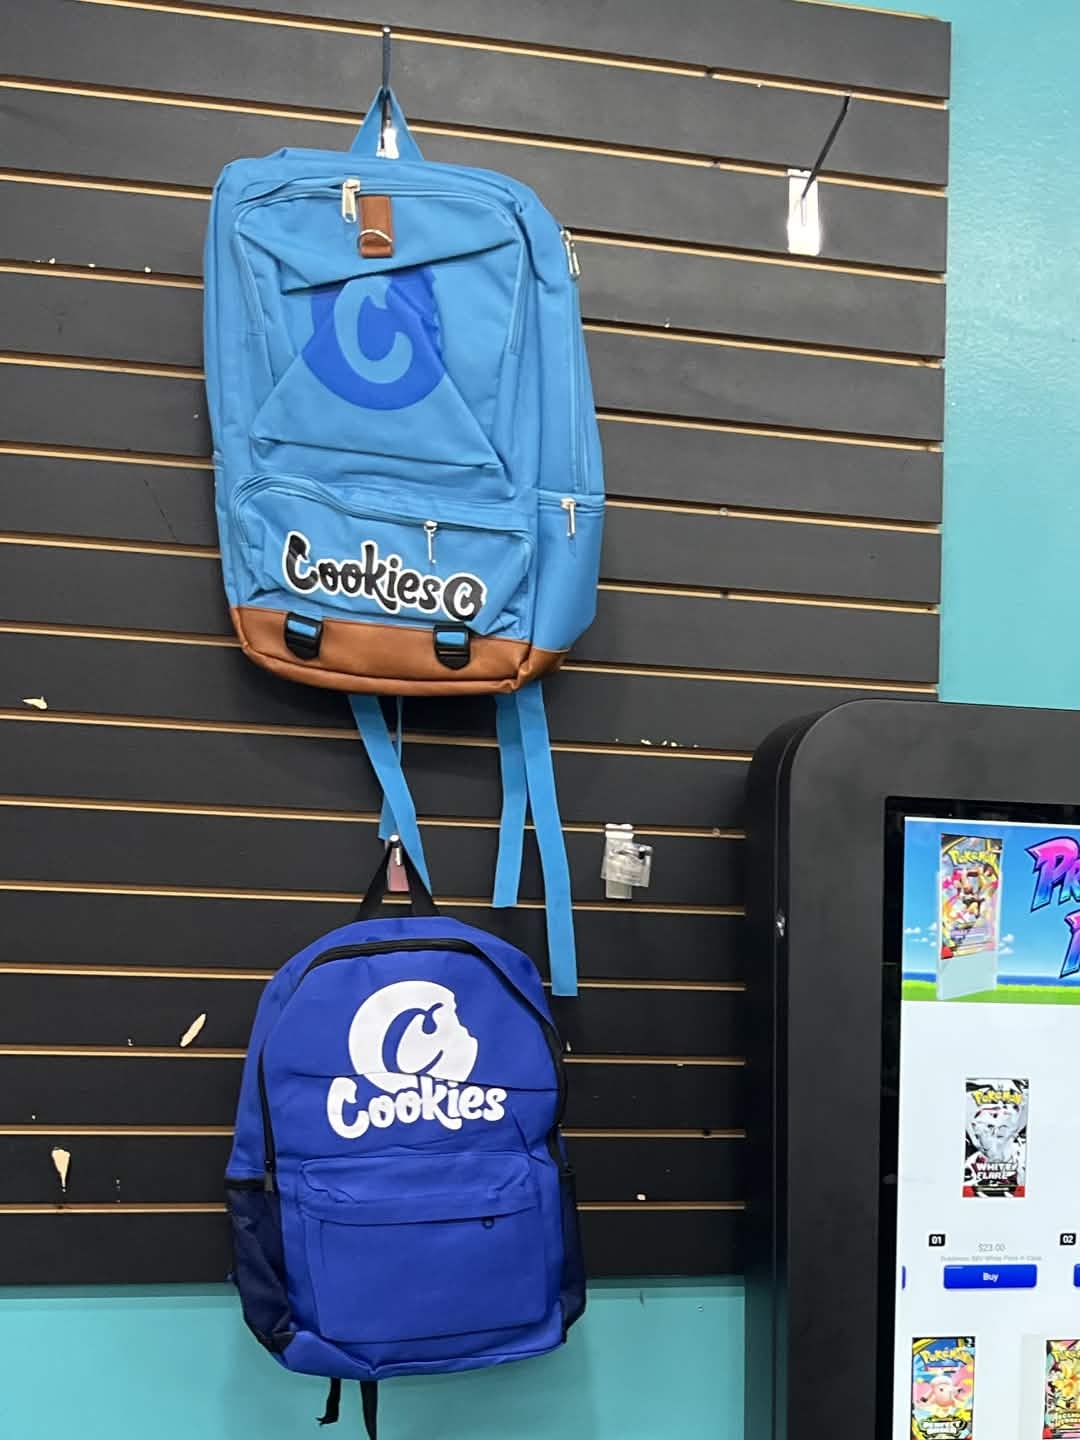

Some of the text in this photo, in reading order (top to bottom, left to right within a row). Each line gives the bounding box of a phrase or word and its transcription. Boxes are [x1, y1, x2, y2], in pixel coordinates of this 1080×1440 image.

[283, 531, 442, 612] Cookies
[327, 1076, 508, 1139] Cookies
[931, 1235, 942, 1245] 01
[1062, 1235, 1074, 1244] 02
[982, 1272, 999, 1283] Buy
